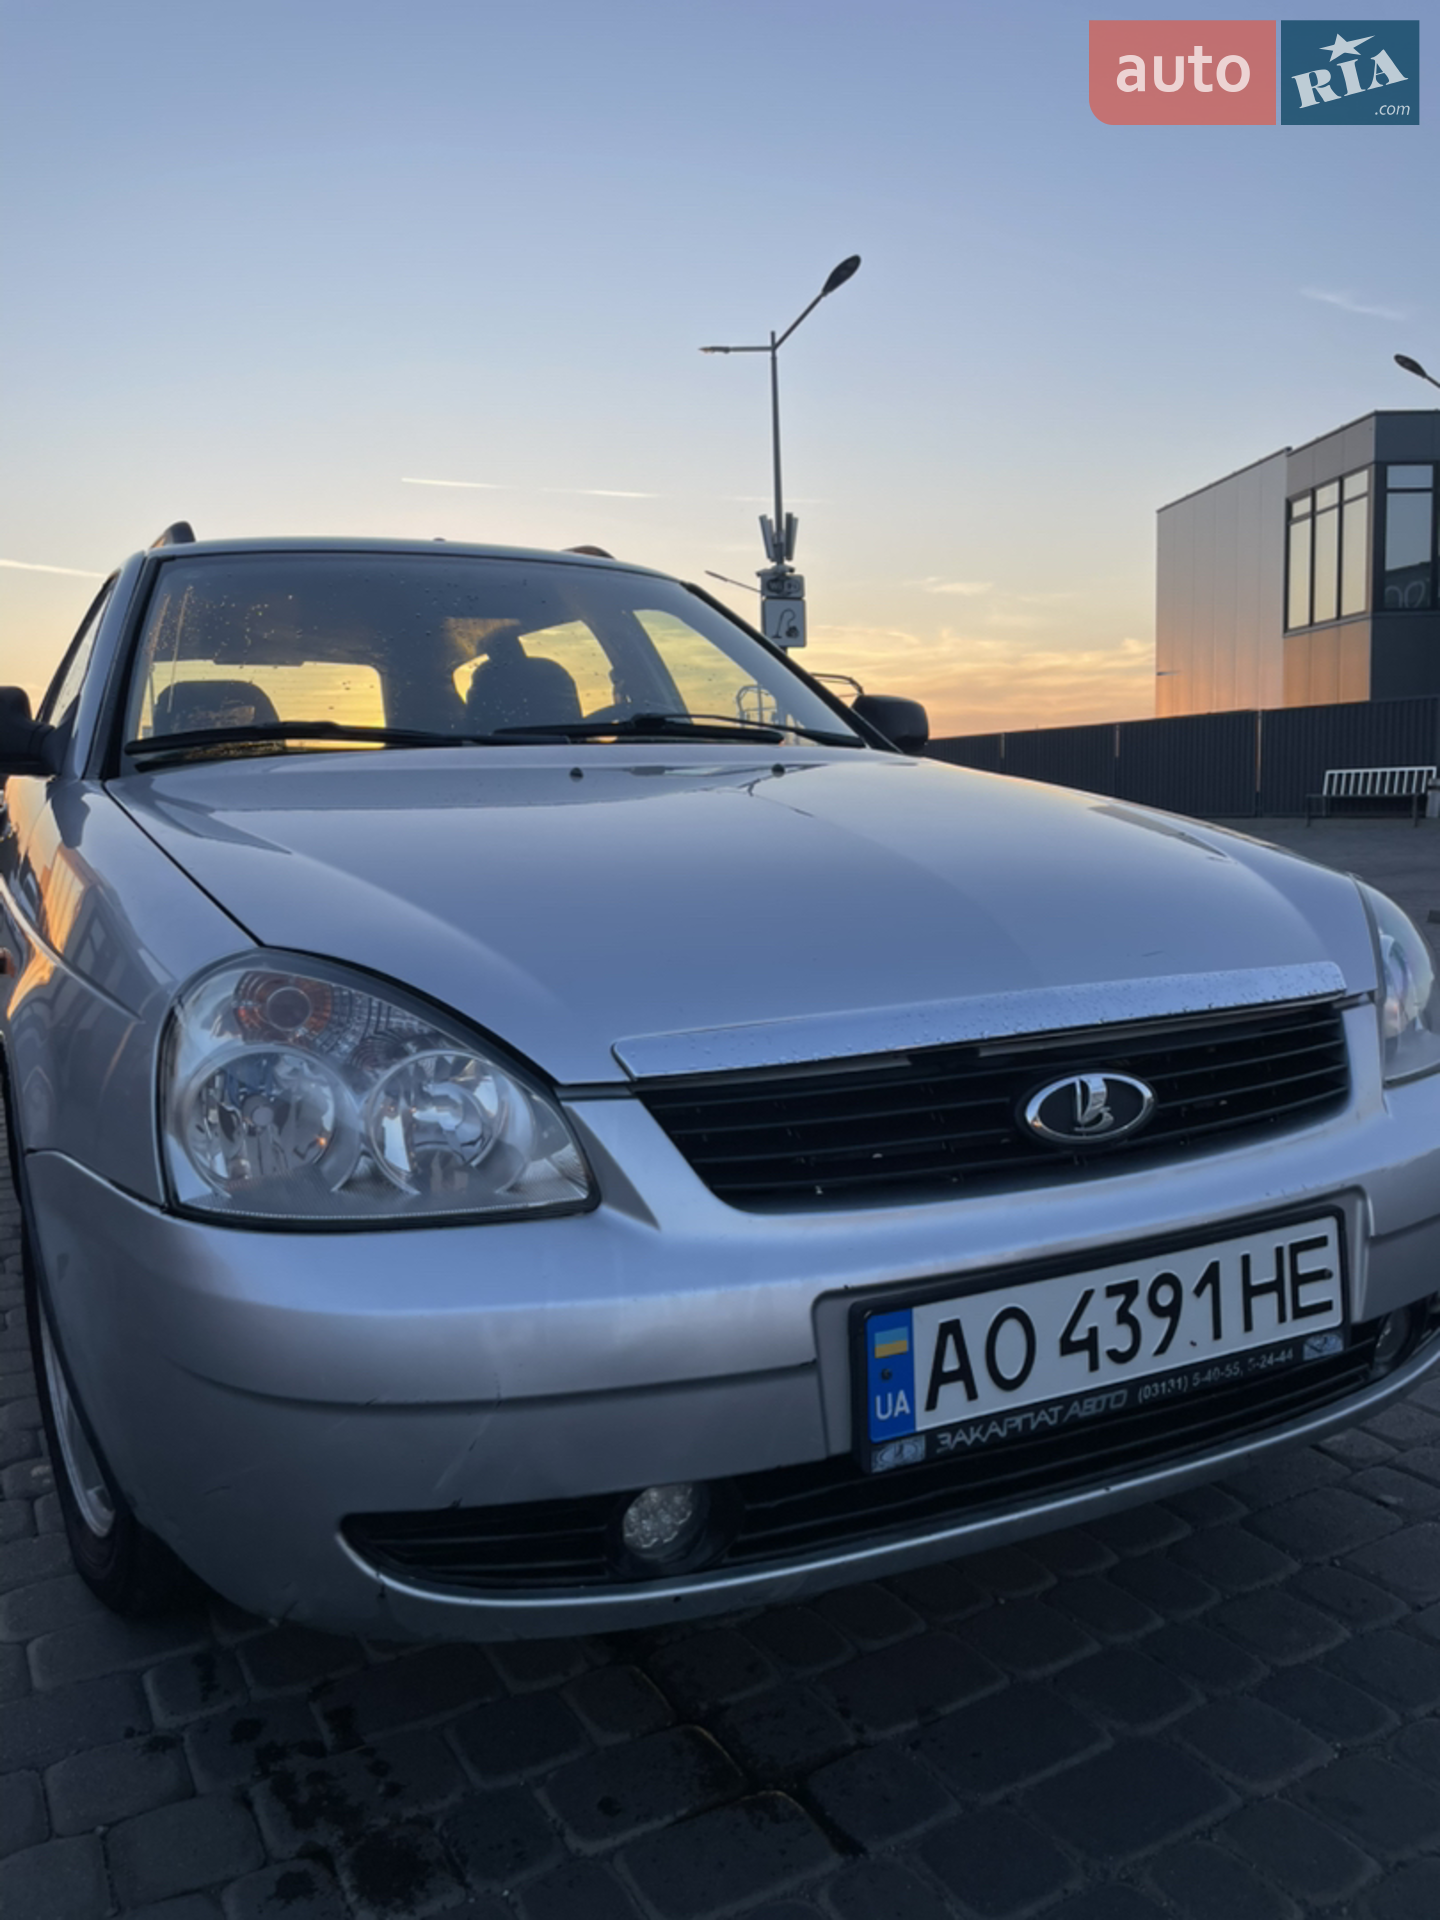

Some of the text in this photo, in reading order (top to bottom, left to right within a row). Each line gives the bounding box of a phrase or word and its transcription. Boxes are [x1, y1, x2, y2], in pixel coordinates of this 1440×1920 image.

[925, 1234, 1335, 1412] AO 4391 HE
[875, 1389, 911, 1421] UA
